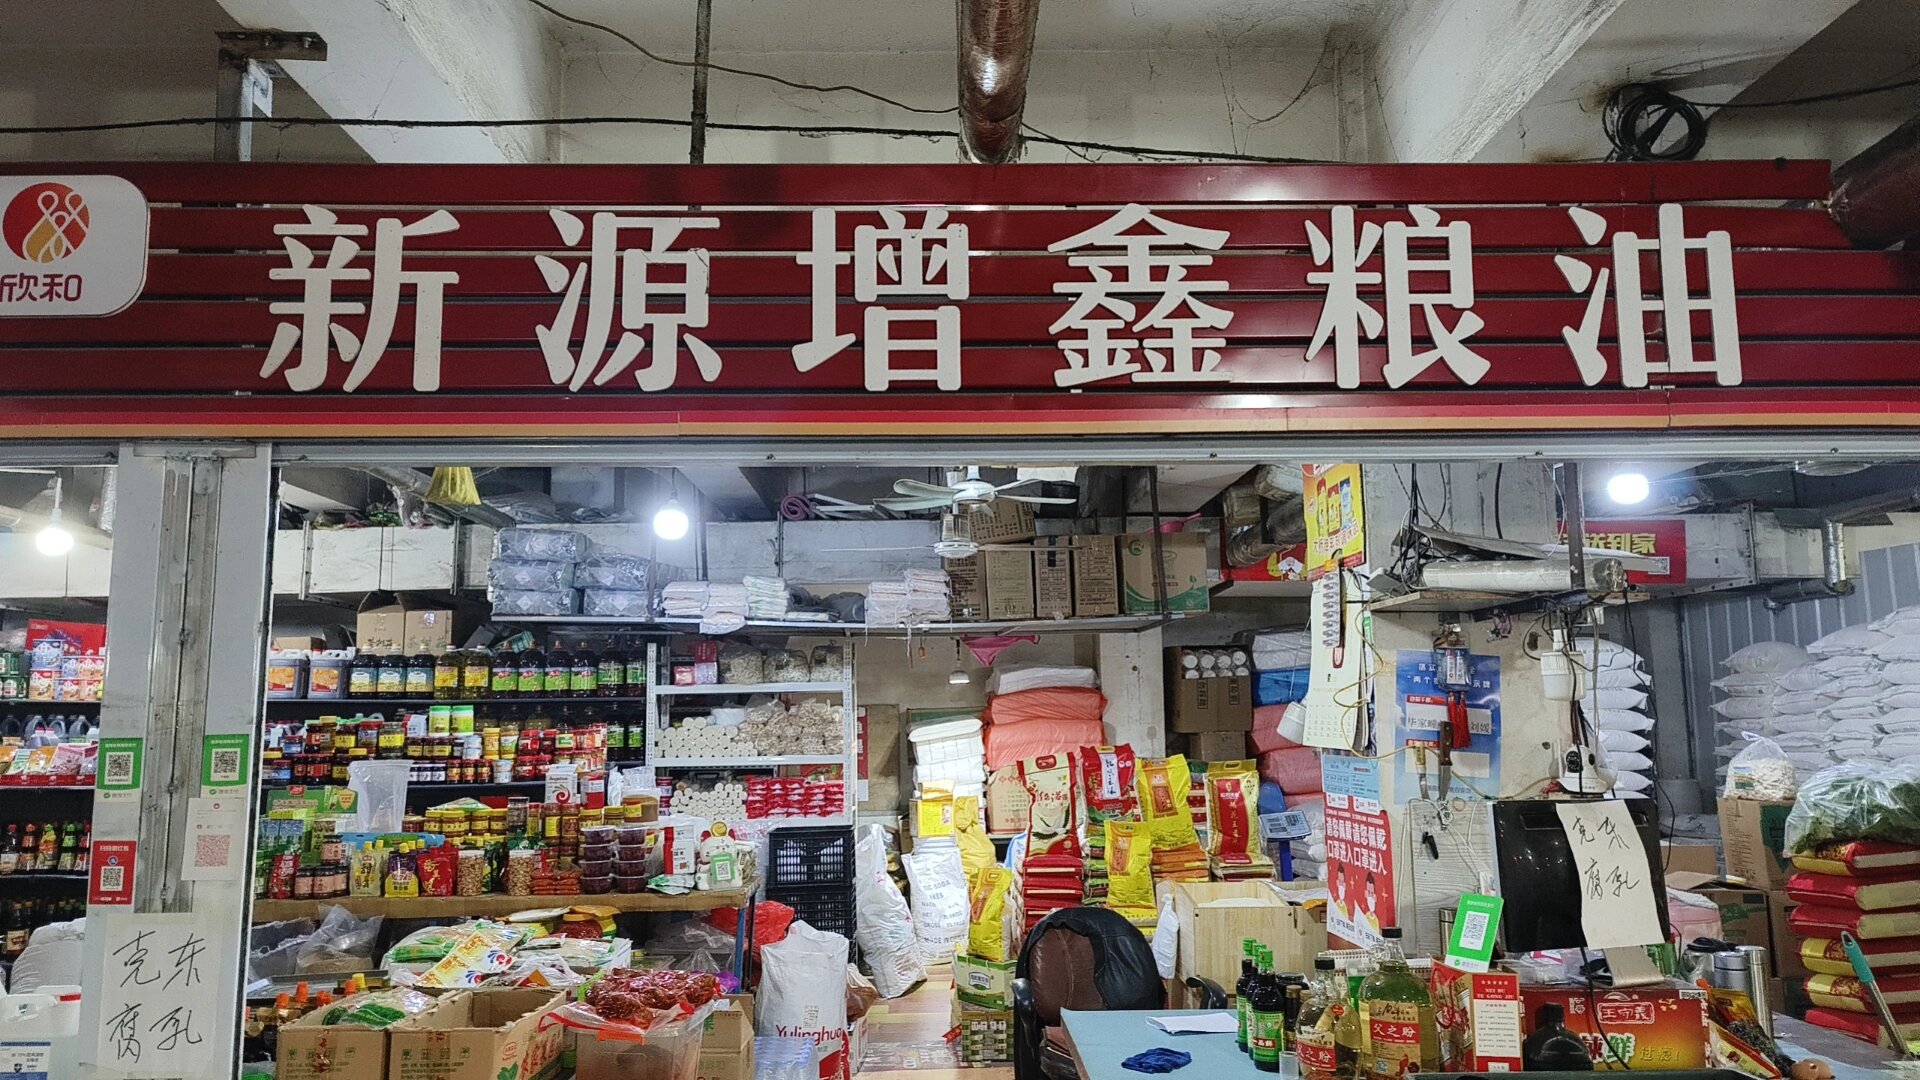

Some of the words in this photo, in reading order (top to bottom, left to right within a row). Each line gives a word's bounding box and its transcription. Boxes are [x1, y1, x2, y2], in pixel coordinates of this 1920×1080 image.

[259, 203, 1743, 394] 新源增鑫粮油
